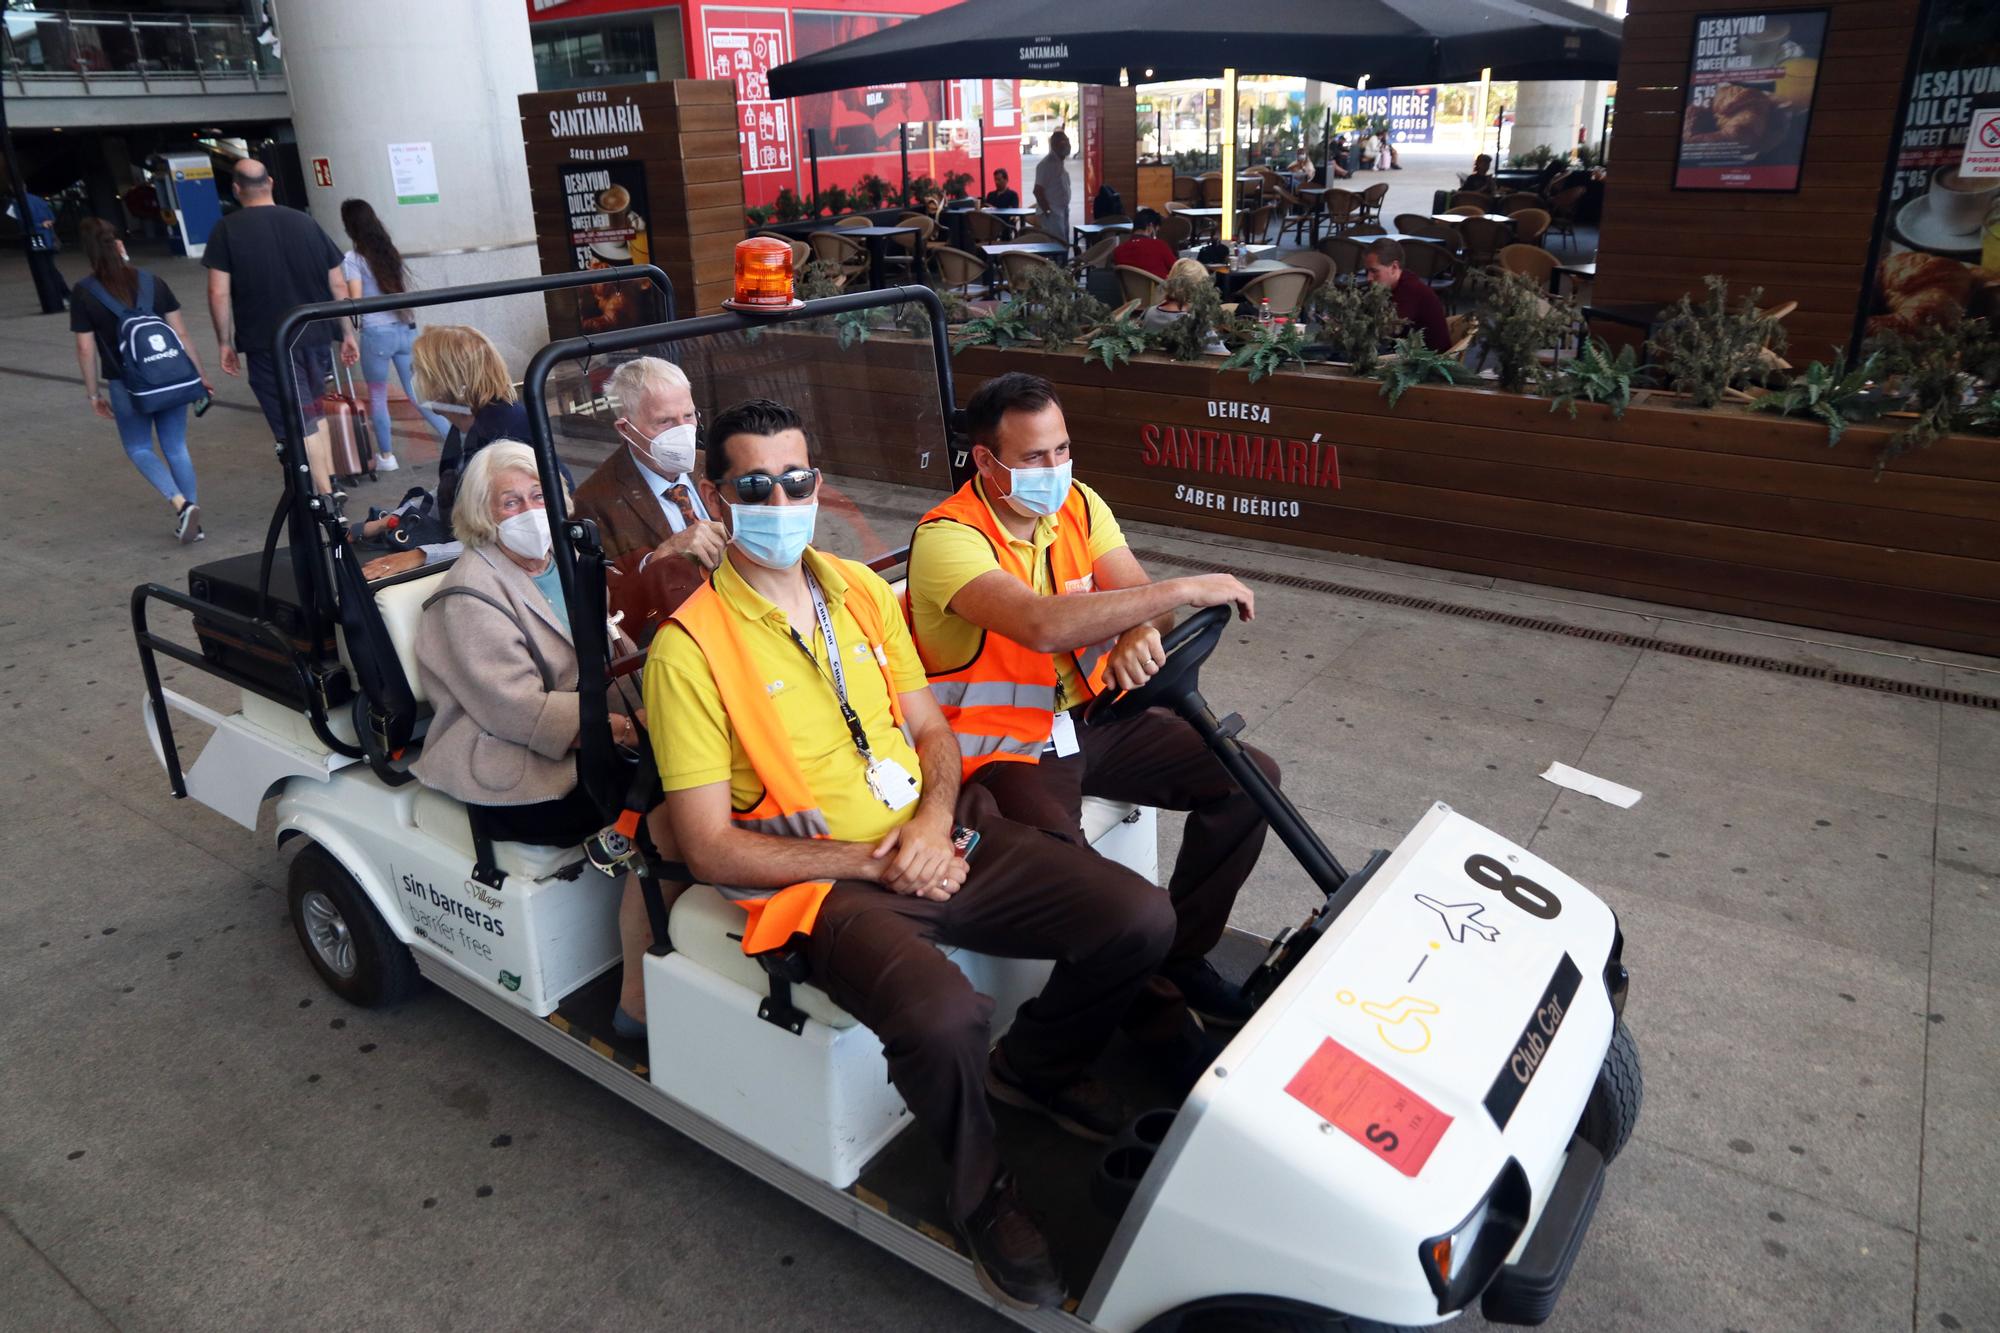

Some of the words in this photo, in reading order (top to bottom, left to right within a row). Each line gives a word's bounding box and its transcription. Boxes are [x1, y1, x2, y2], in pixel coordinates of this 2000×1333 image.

[1700, 15, 1766, 38] DESAYUNO
[1020, 43, 1068, 60] SANTAMARÍA
[1697, 36, 1738, 56] DULCE
[1696, 57, 1726, 71] SWEET
[1727, 55, 1752, 68] MENU
[577, 91, 608, 104] DEHESA
[1357, 95, 1388, 116] BUS
[1391, 94, 1430, 117] HERE
[549, 97, 644, 138] SANTAMARÍA
[1392, 118, 1428, 130] CENTER
[569, 147, 595, 161] SABER
[597, 144, 629, 160] IBÉRICO
[564, 169, 611, 194] DESAYUNO
[567, 191, 597, 214] DULCE
[571, 215, 592, 230] SWEET
[592, 213, 611, 227] MENU
[1207, 401, 1271, 424] DEHESA
[1139, 423, 1342, 490] SANTAMARÍA
[1175, 484, 1226, 511] SABER
[1233, 496, 1300, 518] IBÉRICO
[1464, 853, 1562, 920] 8
[402, 873, 427, 900] sin
[429, 883, 505, 937] barreras
[409, 901, 456, 942] barrier
[459, 927, 494, 961] free
[1511, 1032, 1545, 1085] Club
[1537, 993, 1564, 1036] Car
[1365, 1123, 1399, 1152] S
